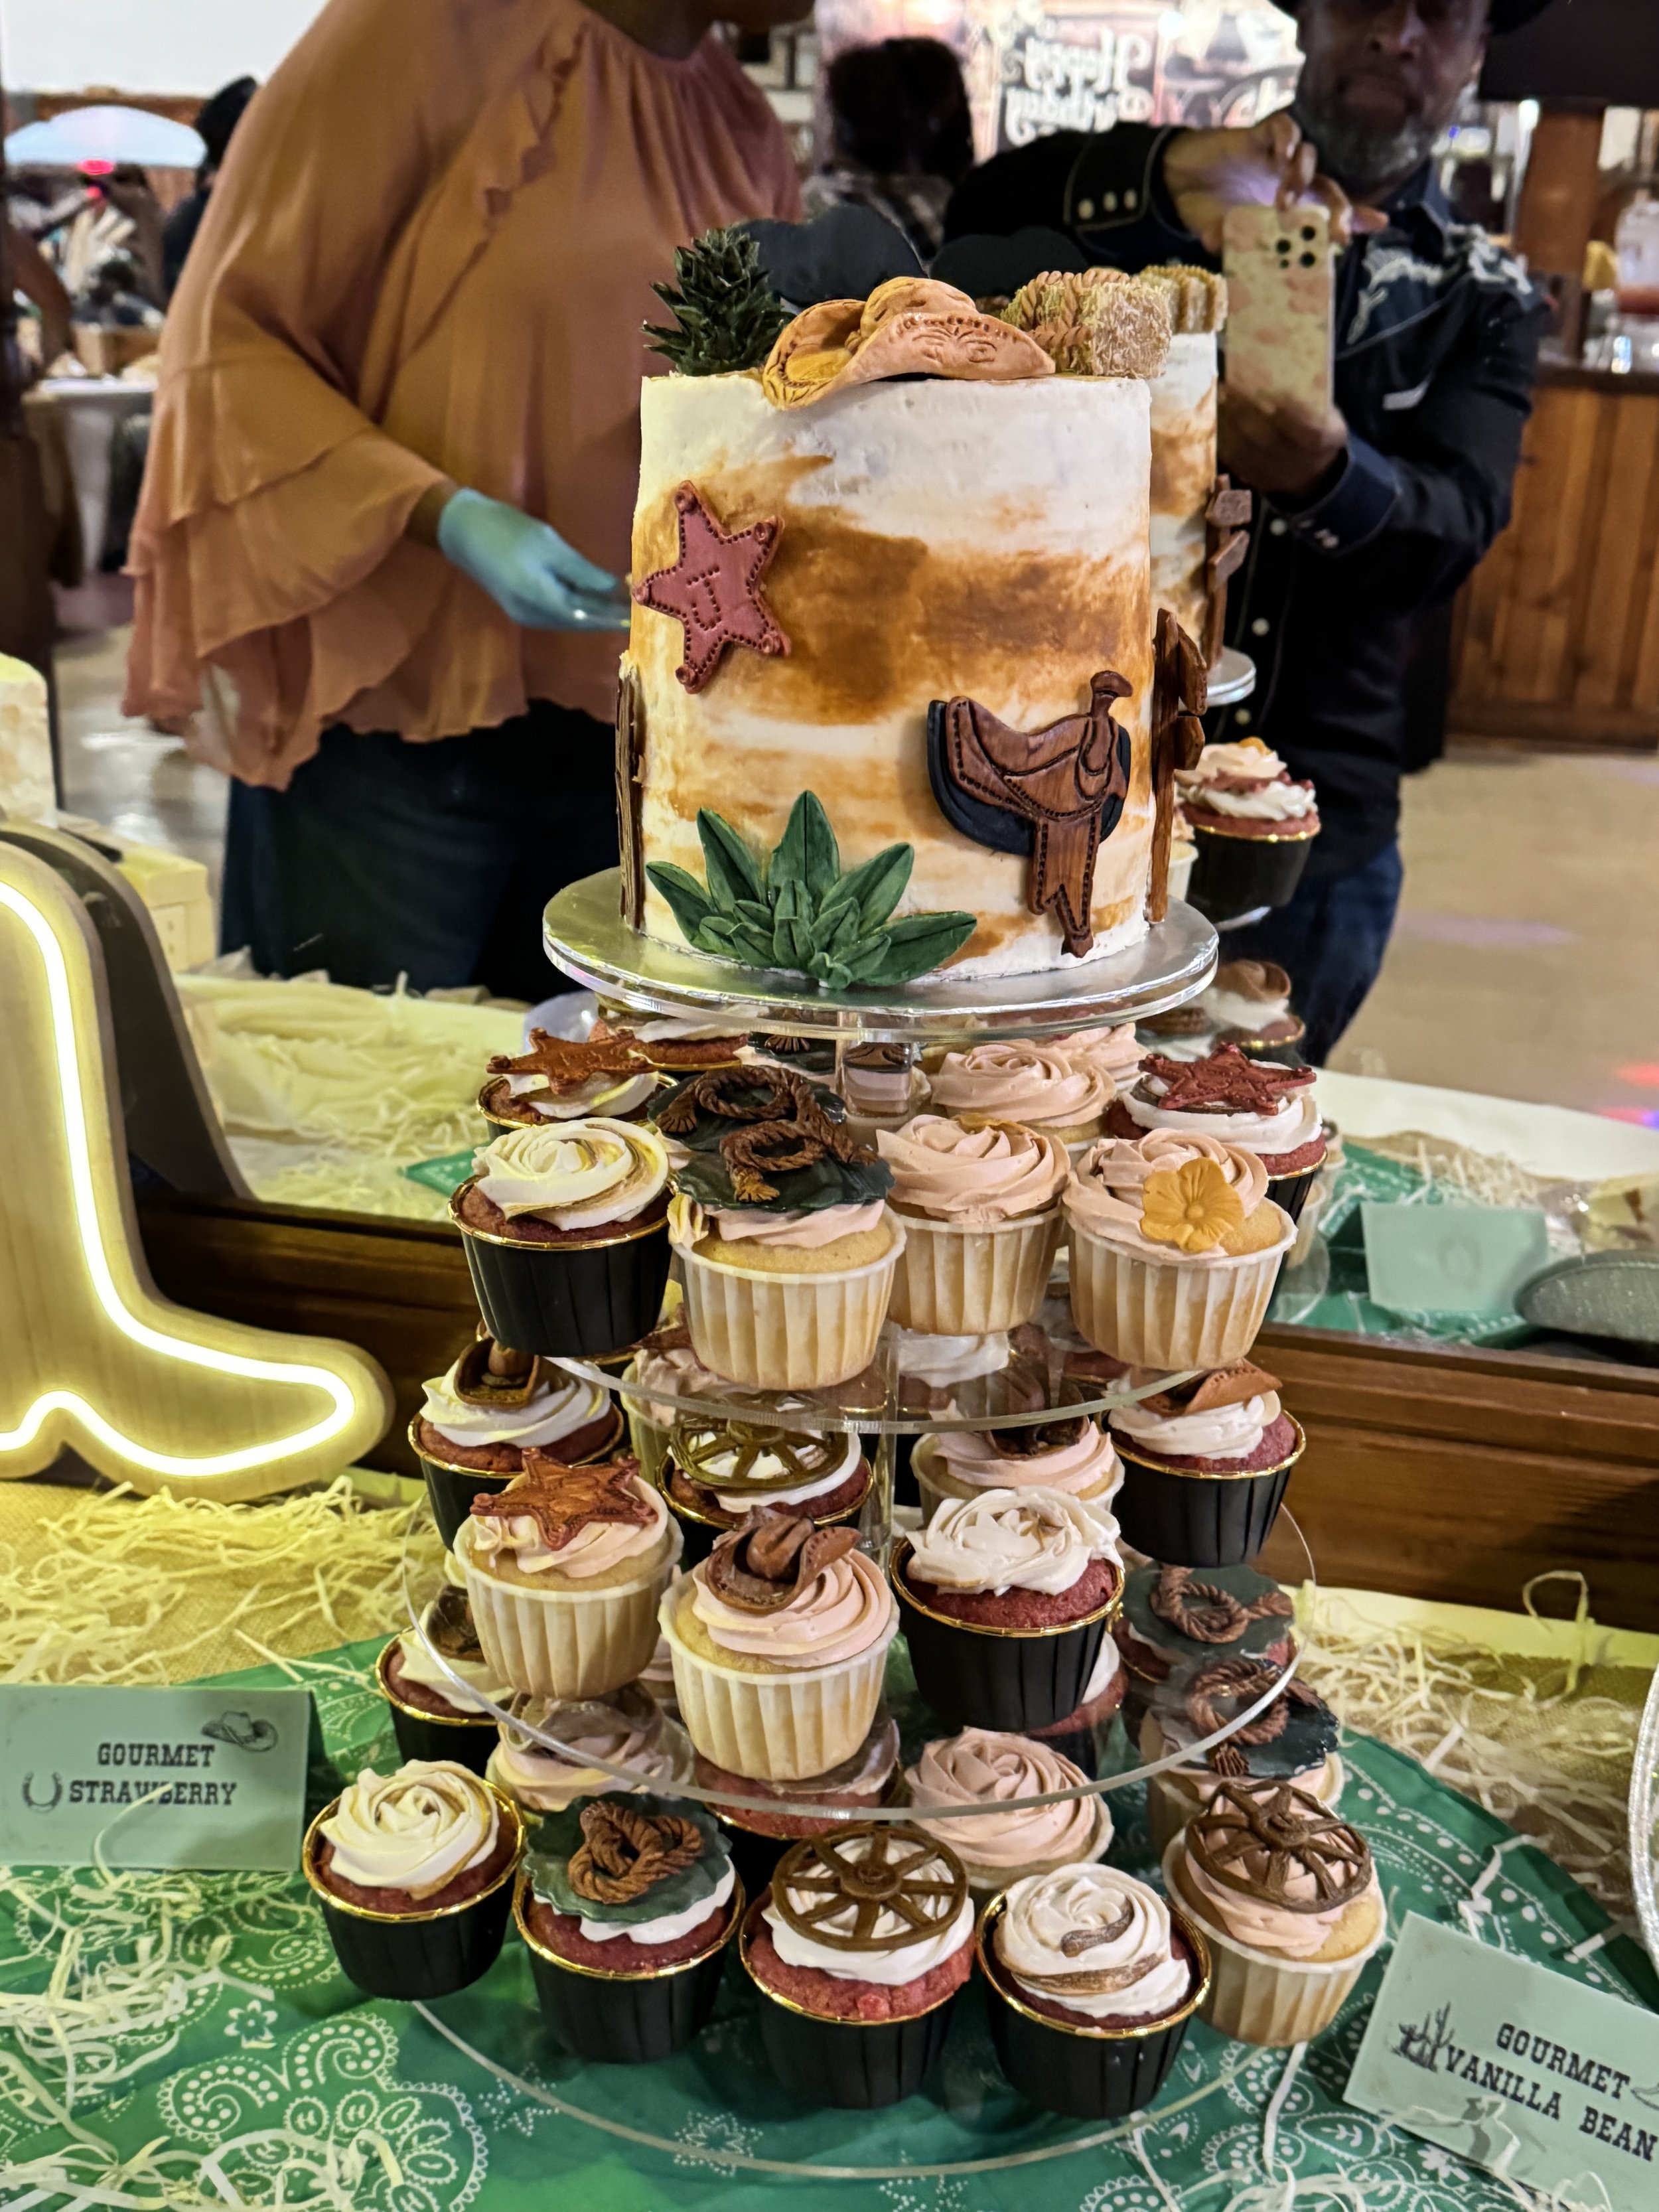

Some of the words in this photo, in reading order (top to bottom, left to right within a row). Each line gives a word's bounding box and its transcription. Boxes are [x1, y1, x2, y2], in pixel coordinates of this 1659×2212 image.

[98, 1742, 215, 1767] GOURMET
[1496, 2022, 1630, 2100] GOURMET
[1445, 2045, 1561, 2121] VANILLA
[1579, 2105, 1658, 2162] BEAN
